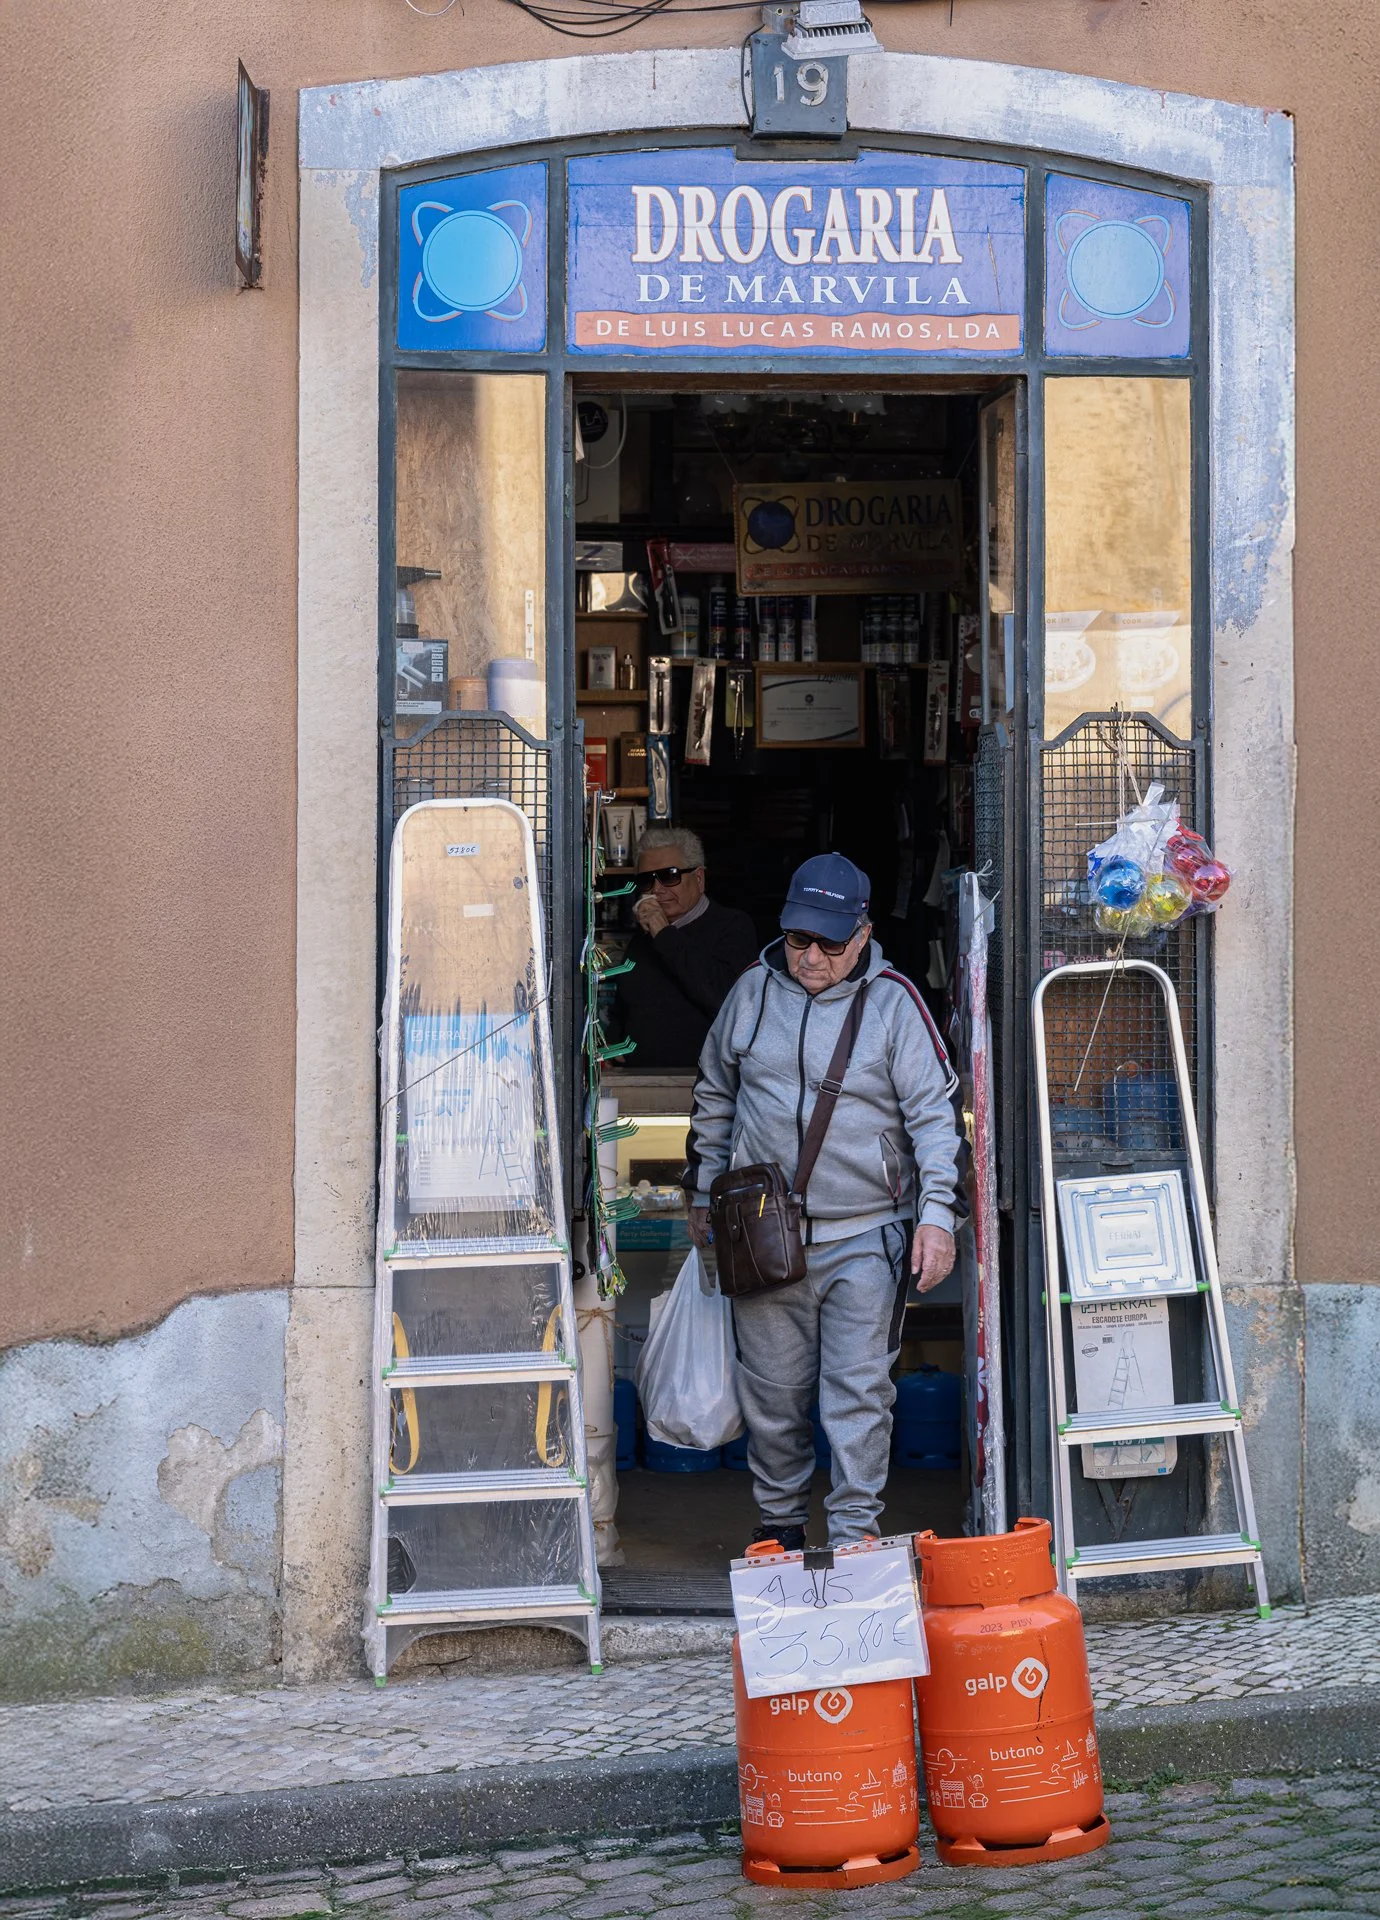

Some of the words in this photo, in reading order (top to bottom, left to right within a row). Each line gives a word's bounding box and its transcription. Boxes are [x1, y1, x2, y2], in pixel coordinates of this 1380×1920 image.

[773, 61, 829, 106] 19
[630, 185, 963, 265] DROGARIA
[636, 274, 706, 303] DE
[726, 275, 972, 305] MARVILA
[596, 319, 630, 337] DE
[645, 320, 706, 338] LUIS
[722, 321, 815, 339] LUCAS
[831, 321, 1000, 341] RAMOS,LDA
[805, 494, 953, 527] DROGARIA
[1092, 1315, 1123, 1324] ESCADOTE
[1125, 1313, 1148, 1322] EUROPA
[980, 1622, 1004, 1634] 2023
[965, 1673, 1008, 1697] galp
[769, 1694, 810, 1716] galp
[989, 1743, 1045, 1763] butano
[788, 1769, 843, 1783] butano
